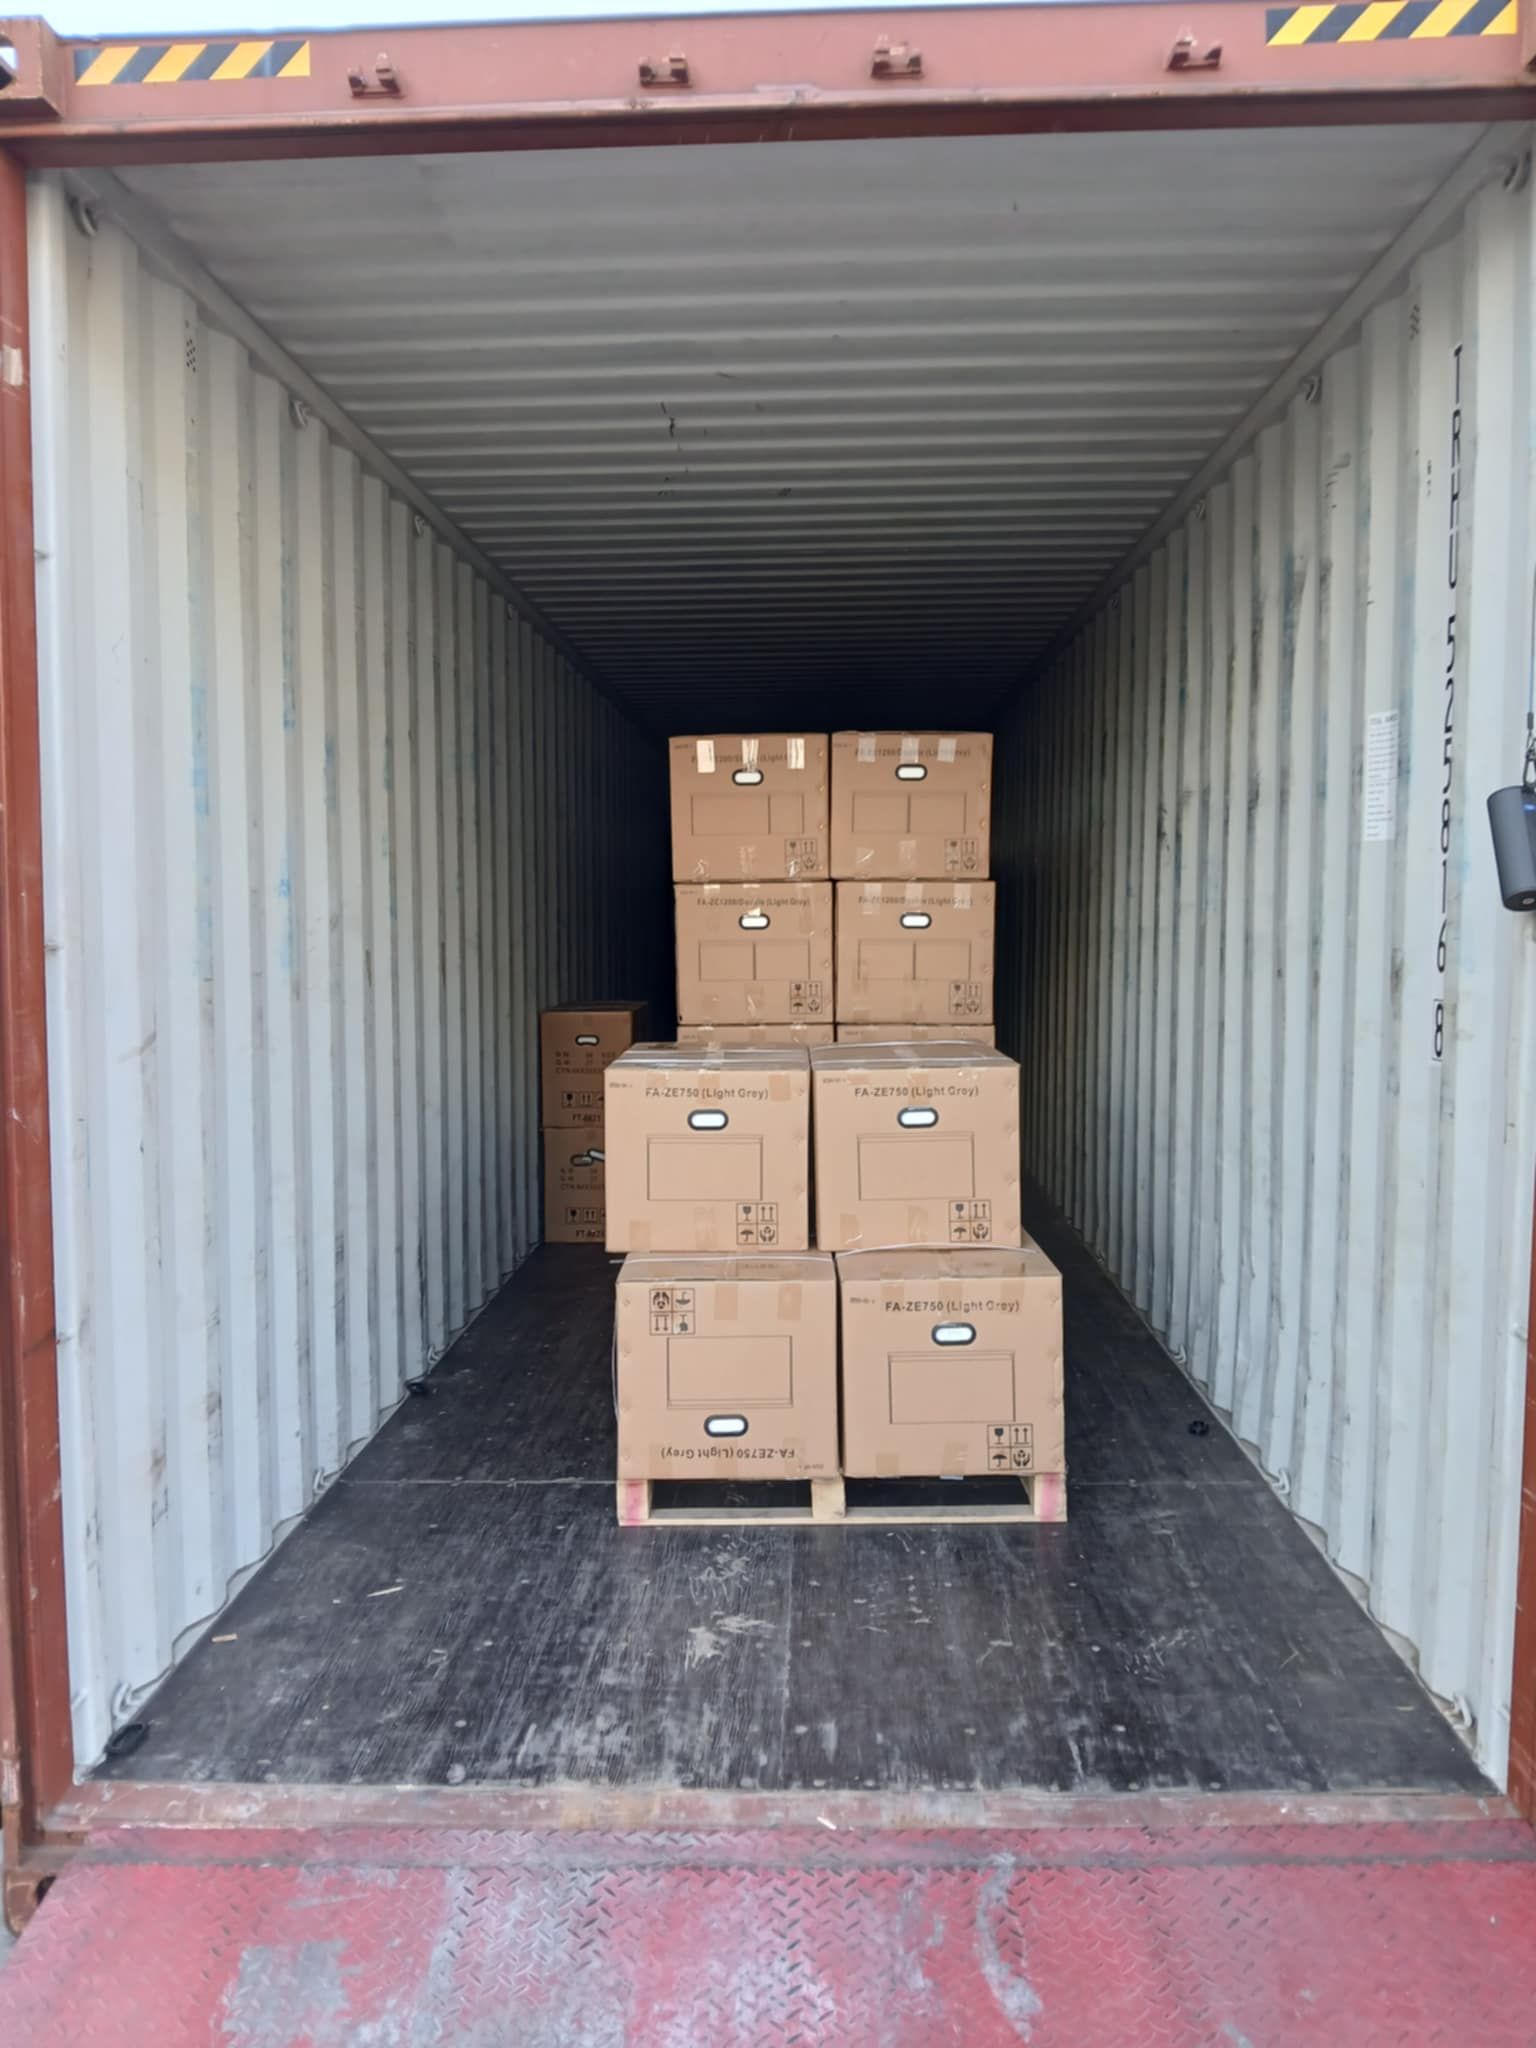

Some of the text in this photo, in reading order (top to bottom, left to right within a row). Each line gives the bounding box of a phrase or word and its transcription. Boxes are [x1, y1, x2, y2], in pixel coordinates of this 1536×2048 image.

[1434, 344, 1463, 1058] TRHU 525816 8
[645, 1087, 699, 1098] FA-ZE750
[701, 1087, 735, 1100] (Light
[854, 1087, 908, 1097] FA-ZE750
[911, 1086, 944, 1098] (Light
[885, 1301, 944, 1312] FA-ZE750
[946, 1300, 983, 1313] (Light
[698, 1447, 734, 1459] (Light
[736, 1448, 795, 1459] FA-ZE750
